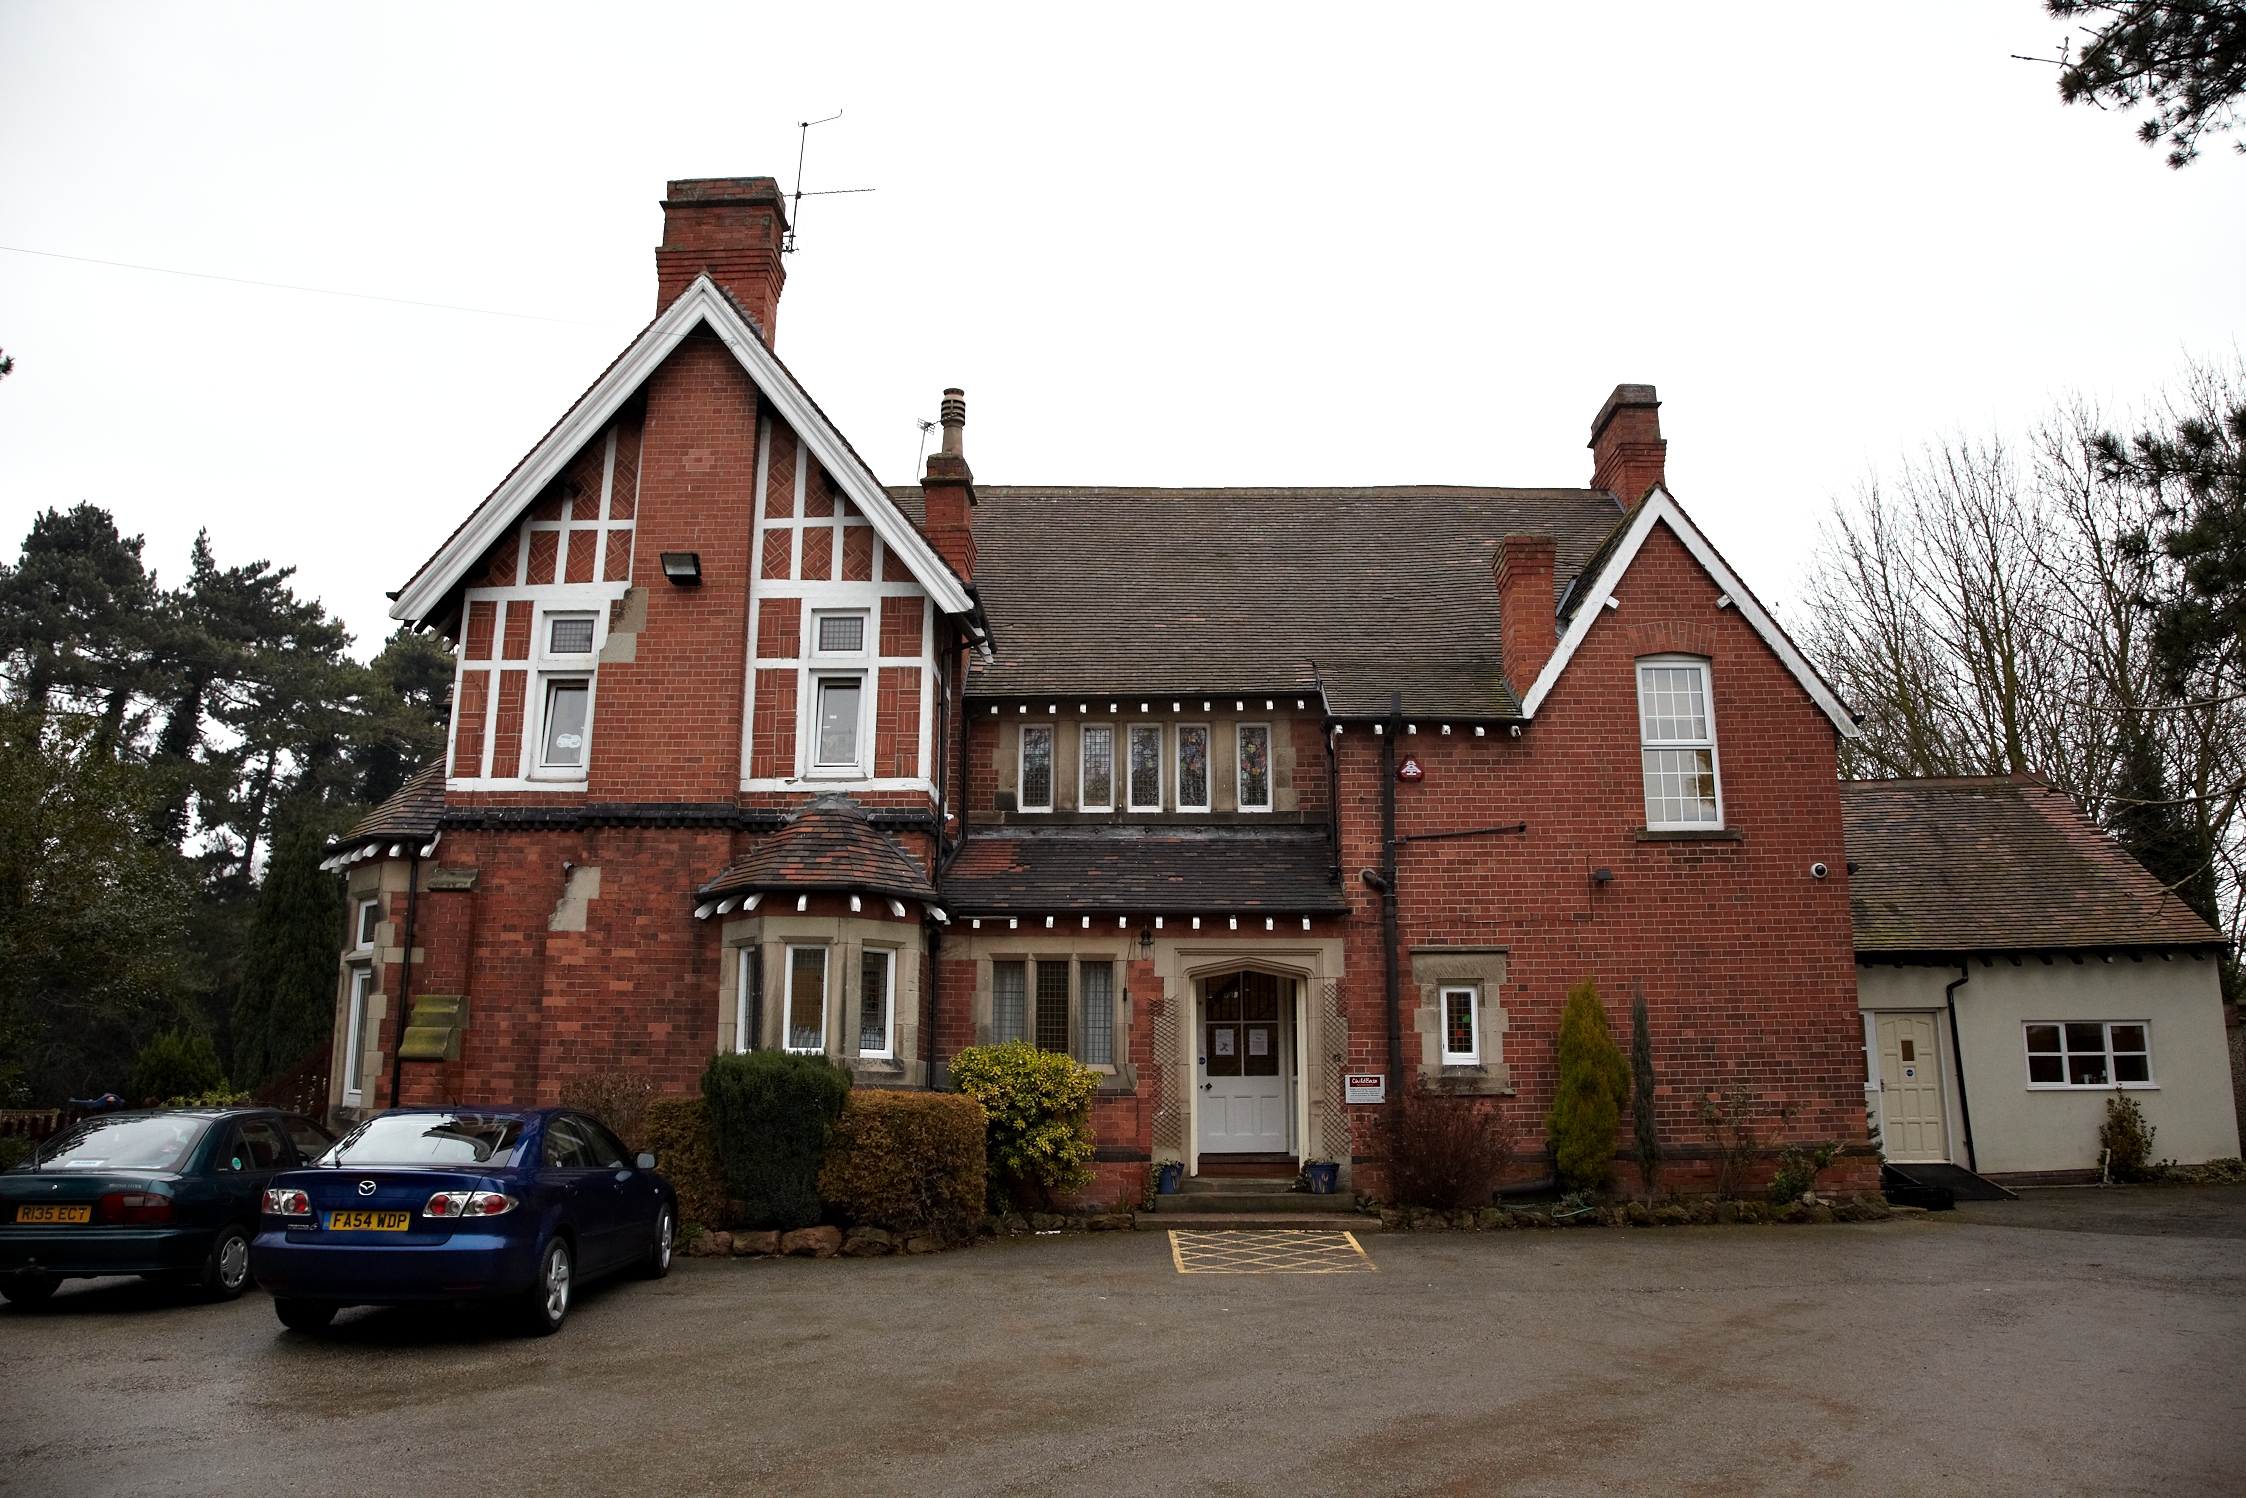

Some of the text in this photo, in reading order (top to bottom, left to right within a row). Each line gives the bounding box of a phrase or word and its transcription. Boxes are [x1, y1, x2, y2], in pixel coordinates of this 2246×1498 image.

[21, 1206, 87, 1220] R135 ECT
[332, 1213, 407, 1229] FA54 WDP
